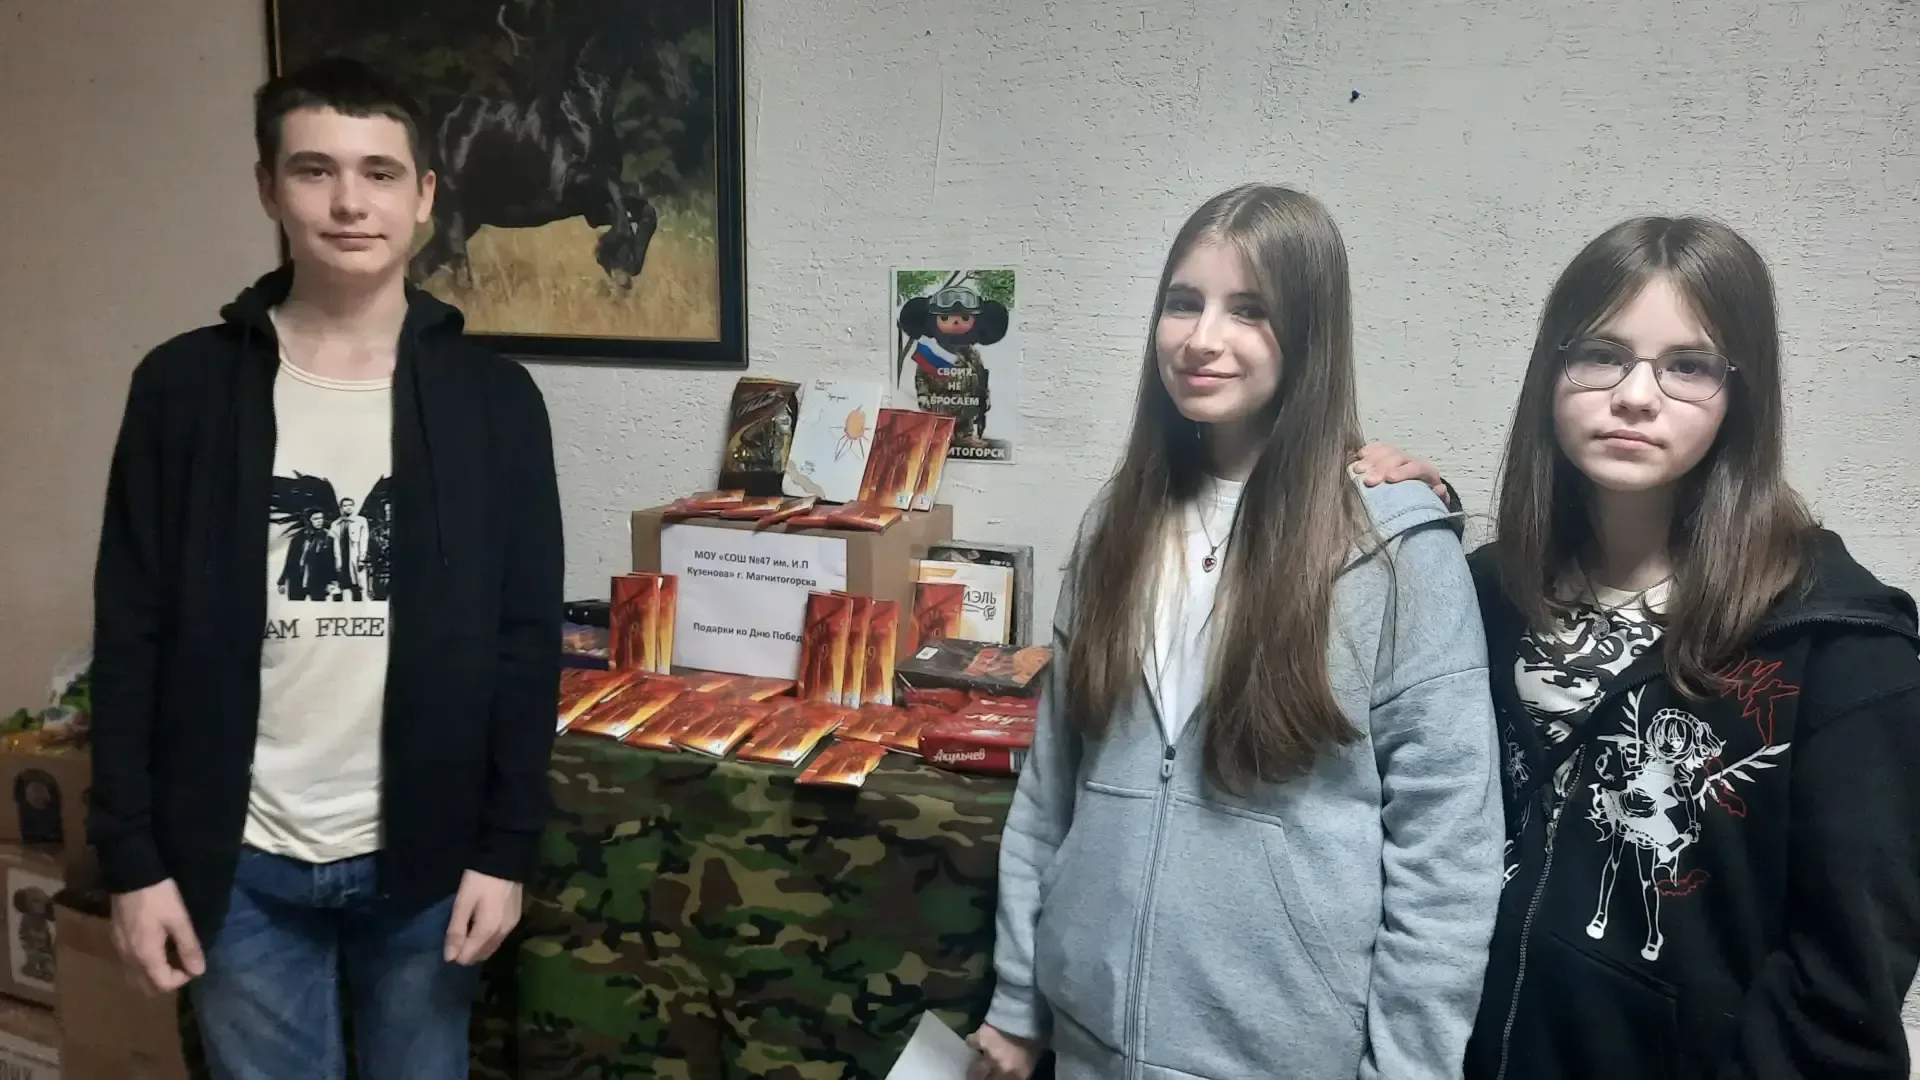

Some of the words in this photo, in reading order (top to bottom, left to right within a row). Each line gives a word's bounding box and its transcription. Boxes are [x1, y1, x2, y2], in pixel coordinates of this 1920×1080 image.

[937, 367, 973, 377] СВОИХ
[947, 380, 962, 391] НЕ
[930, 396, 980, 406] БРОСАЕМ
[694, 550, 717, 560] МОУ
[719, 553, 747, 563] «СОШ
[748, 555, 770, 566] №47
[773, 559, 789, 567] им.
[791, 559, 809, 569] И.П
[687, 566, 735, 579] Кузенова»
[737, 571, 744, 579] г.
[746, 571, 817, 587] Магнитогорска
[263, 617, 301, 639] AM
[315, 616, 385, 638] FREE
[693, 622, 734, 637] Подарки
[736, 628, 748, 636] ко
[749, 628, 771, 639] Дню
[772, 629, 804, 644] Побед
[932, 748, 986, 764] Акульчев
